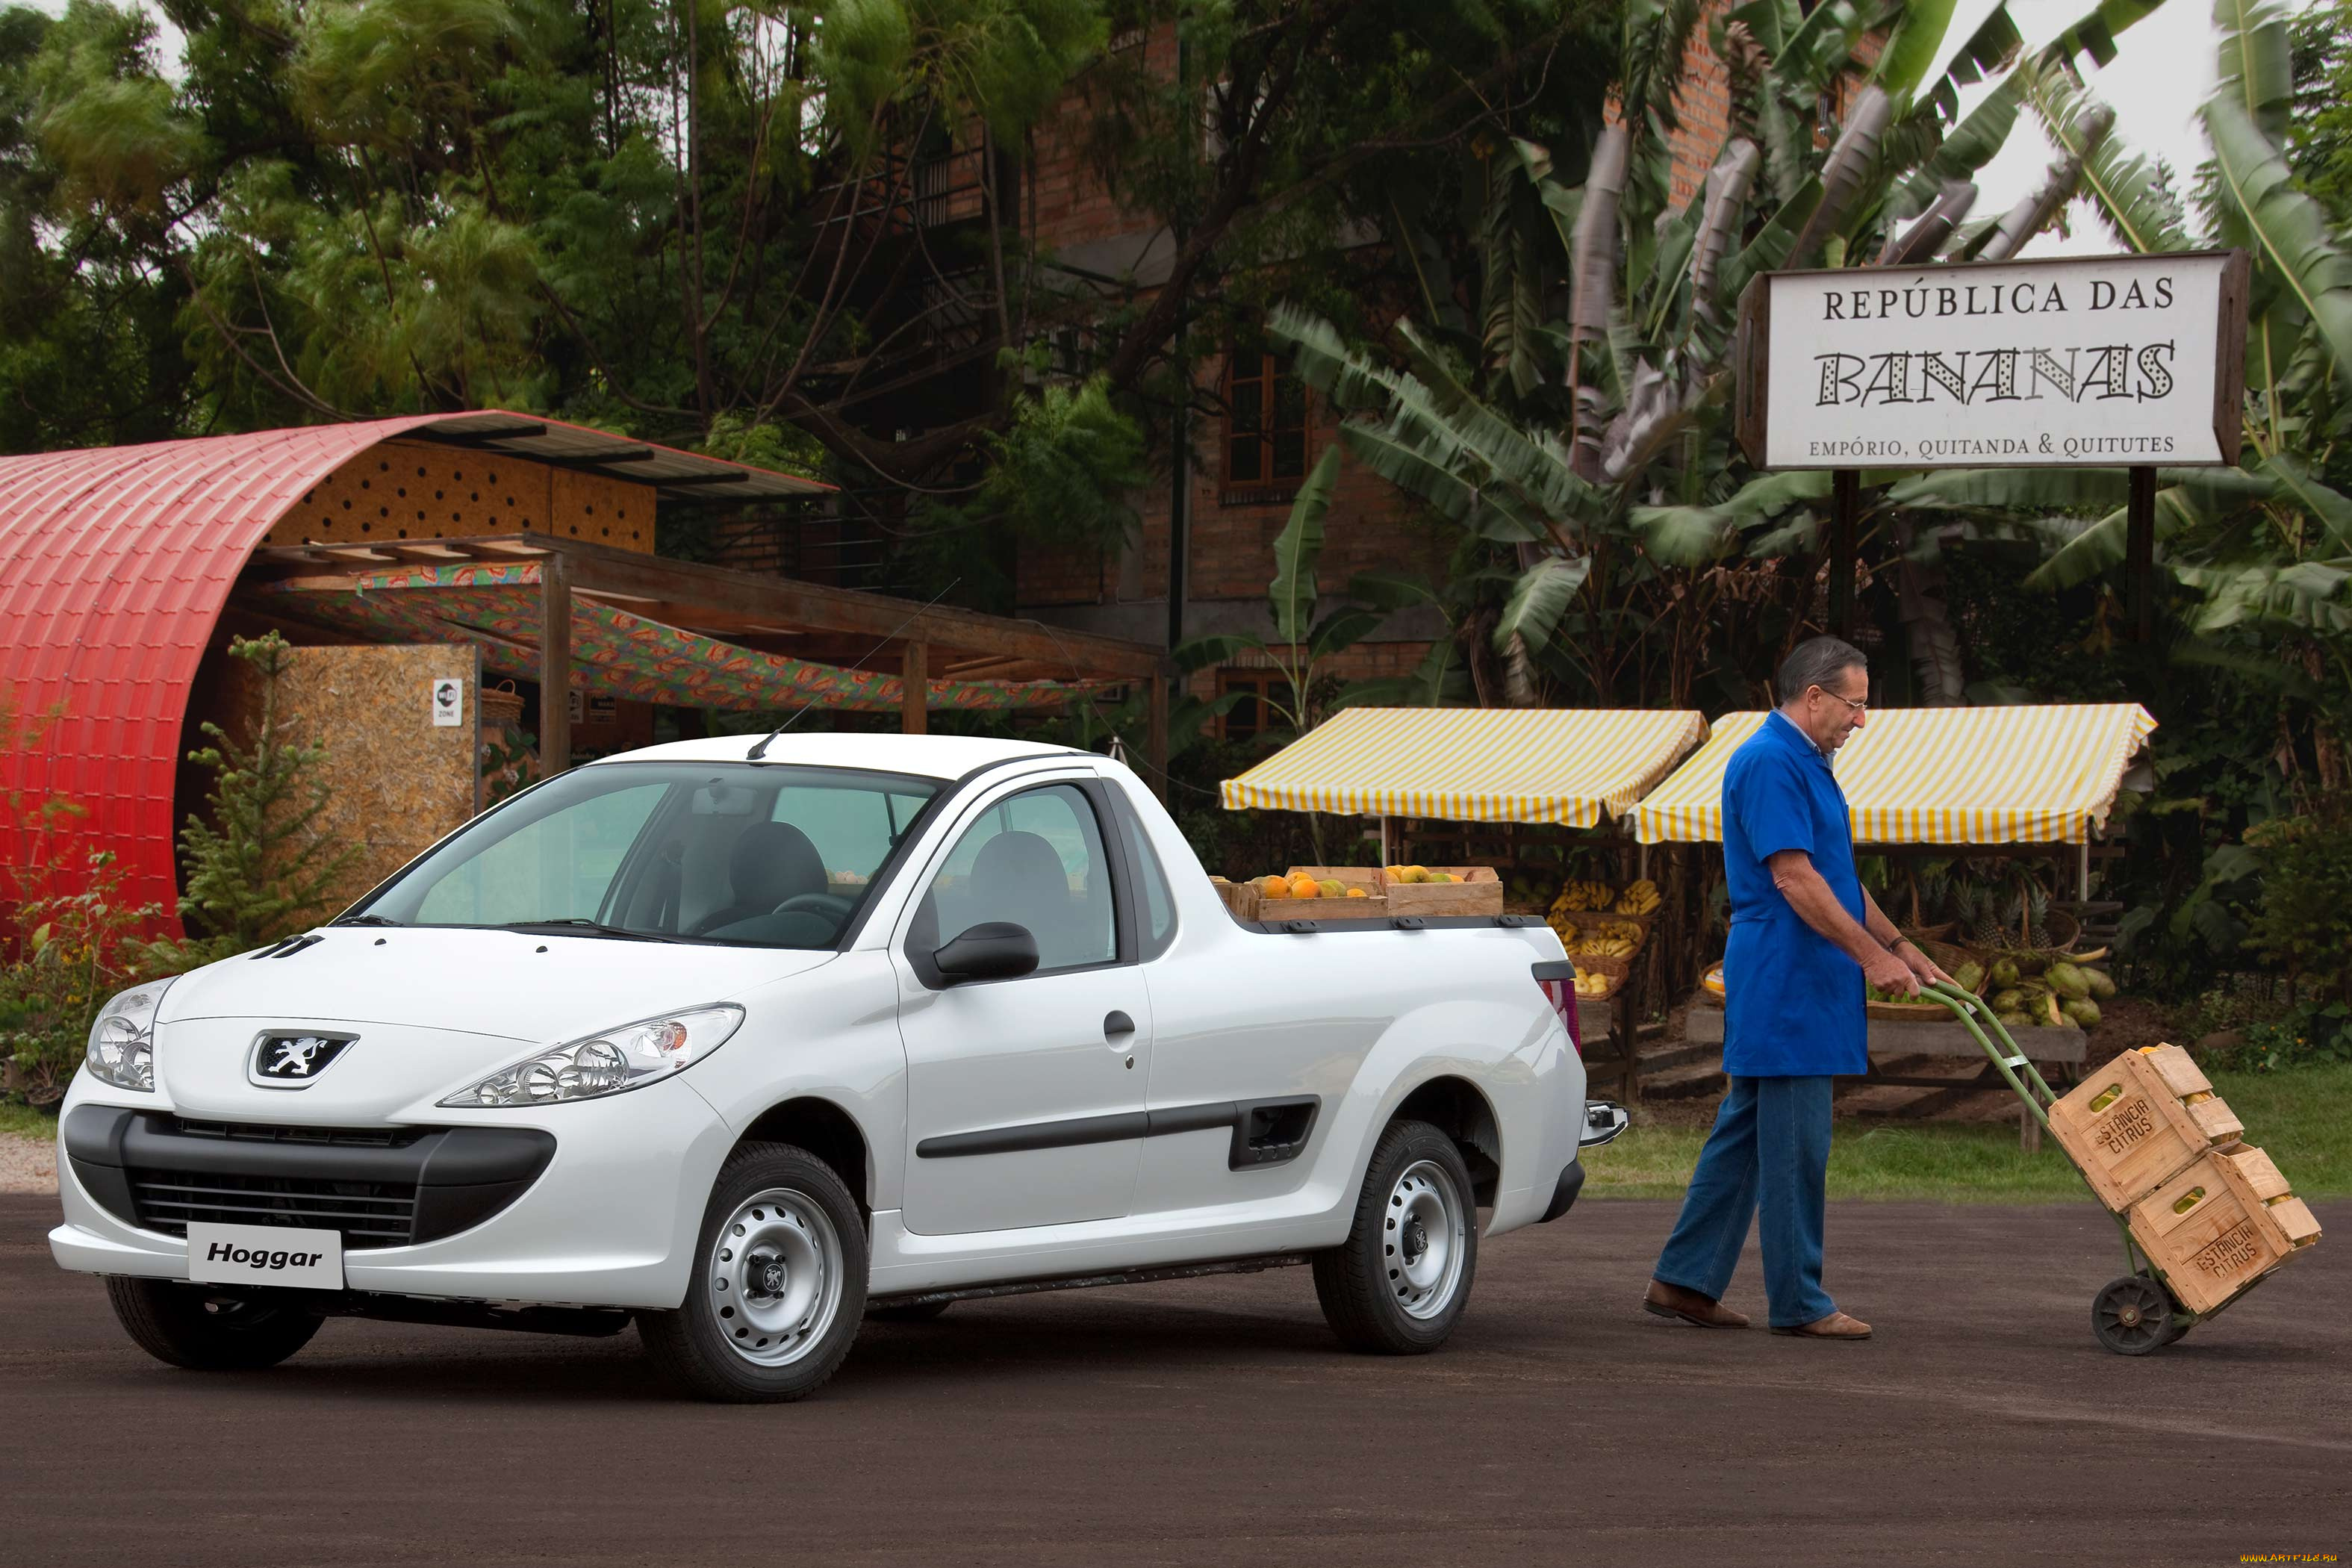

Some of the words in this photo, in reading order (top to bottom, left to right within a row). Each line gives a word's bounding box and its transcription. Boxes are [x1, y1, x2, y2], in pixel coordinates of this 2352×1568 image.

[1822, 276, 2068, 320] REPÚBLICA
[2089, 277, 2174, 311] DAS
[1814, 339, 2174, 408] BANANAS
[1809, 436, 1908, 458] EMPÓRIO,
[1918, 438, 2029, 460] QUITANDA
[2038, 433, 2054, 454] &
[2063, 437, 2174, 458] QUITUTES
[2109, 1117, 2153, 1154] CITRUS
[207, 1242, 323, 1270] Hoggar
[2213, 1243, 2256, 1278] CITRUS
